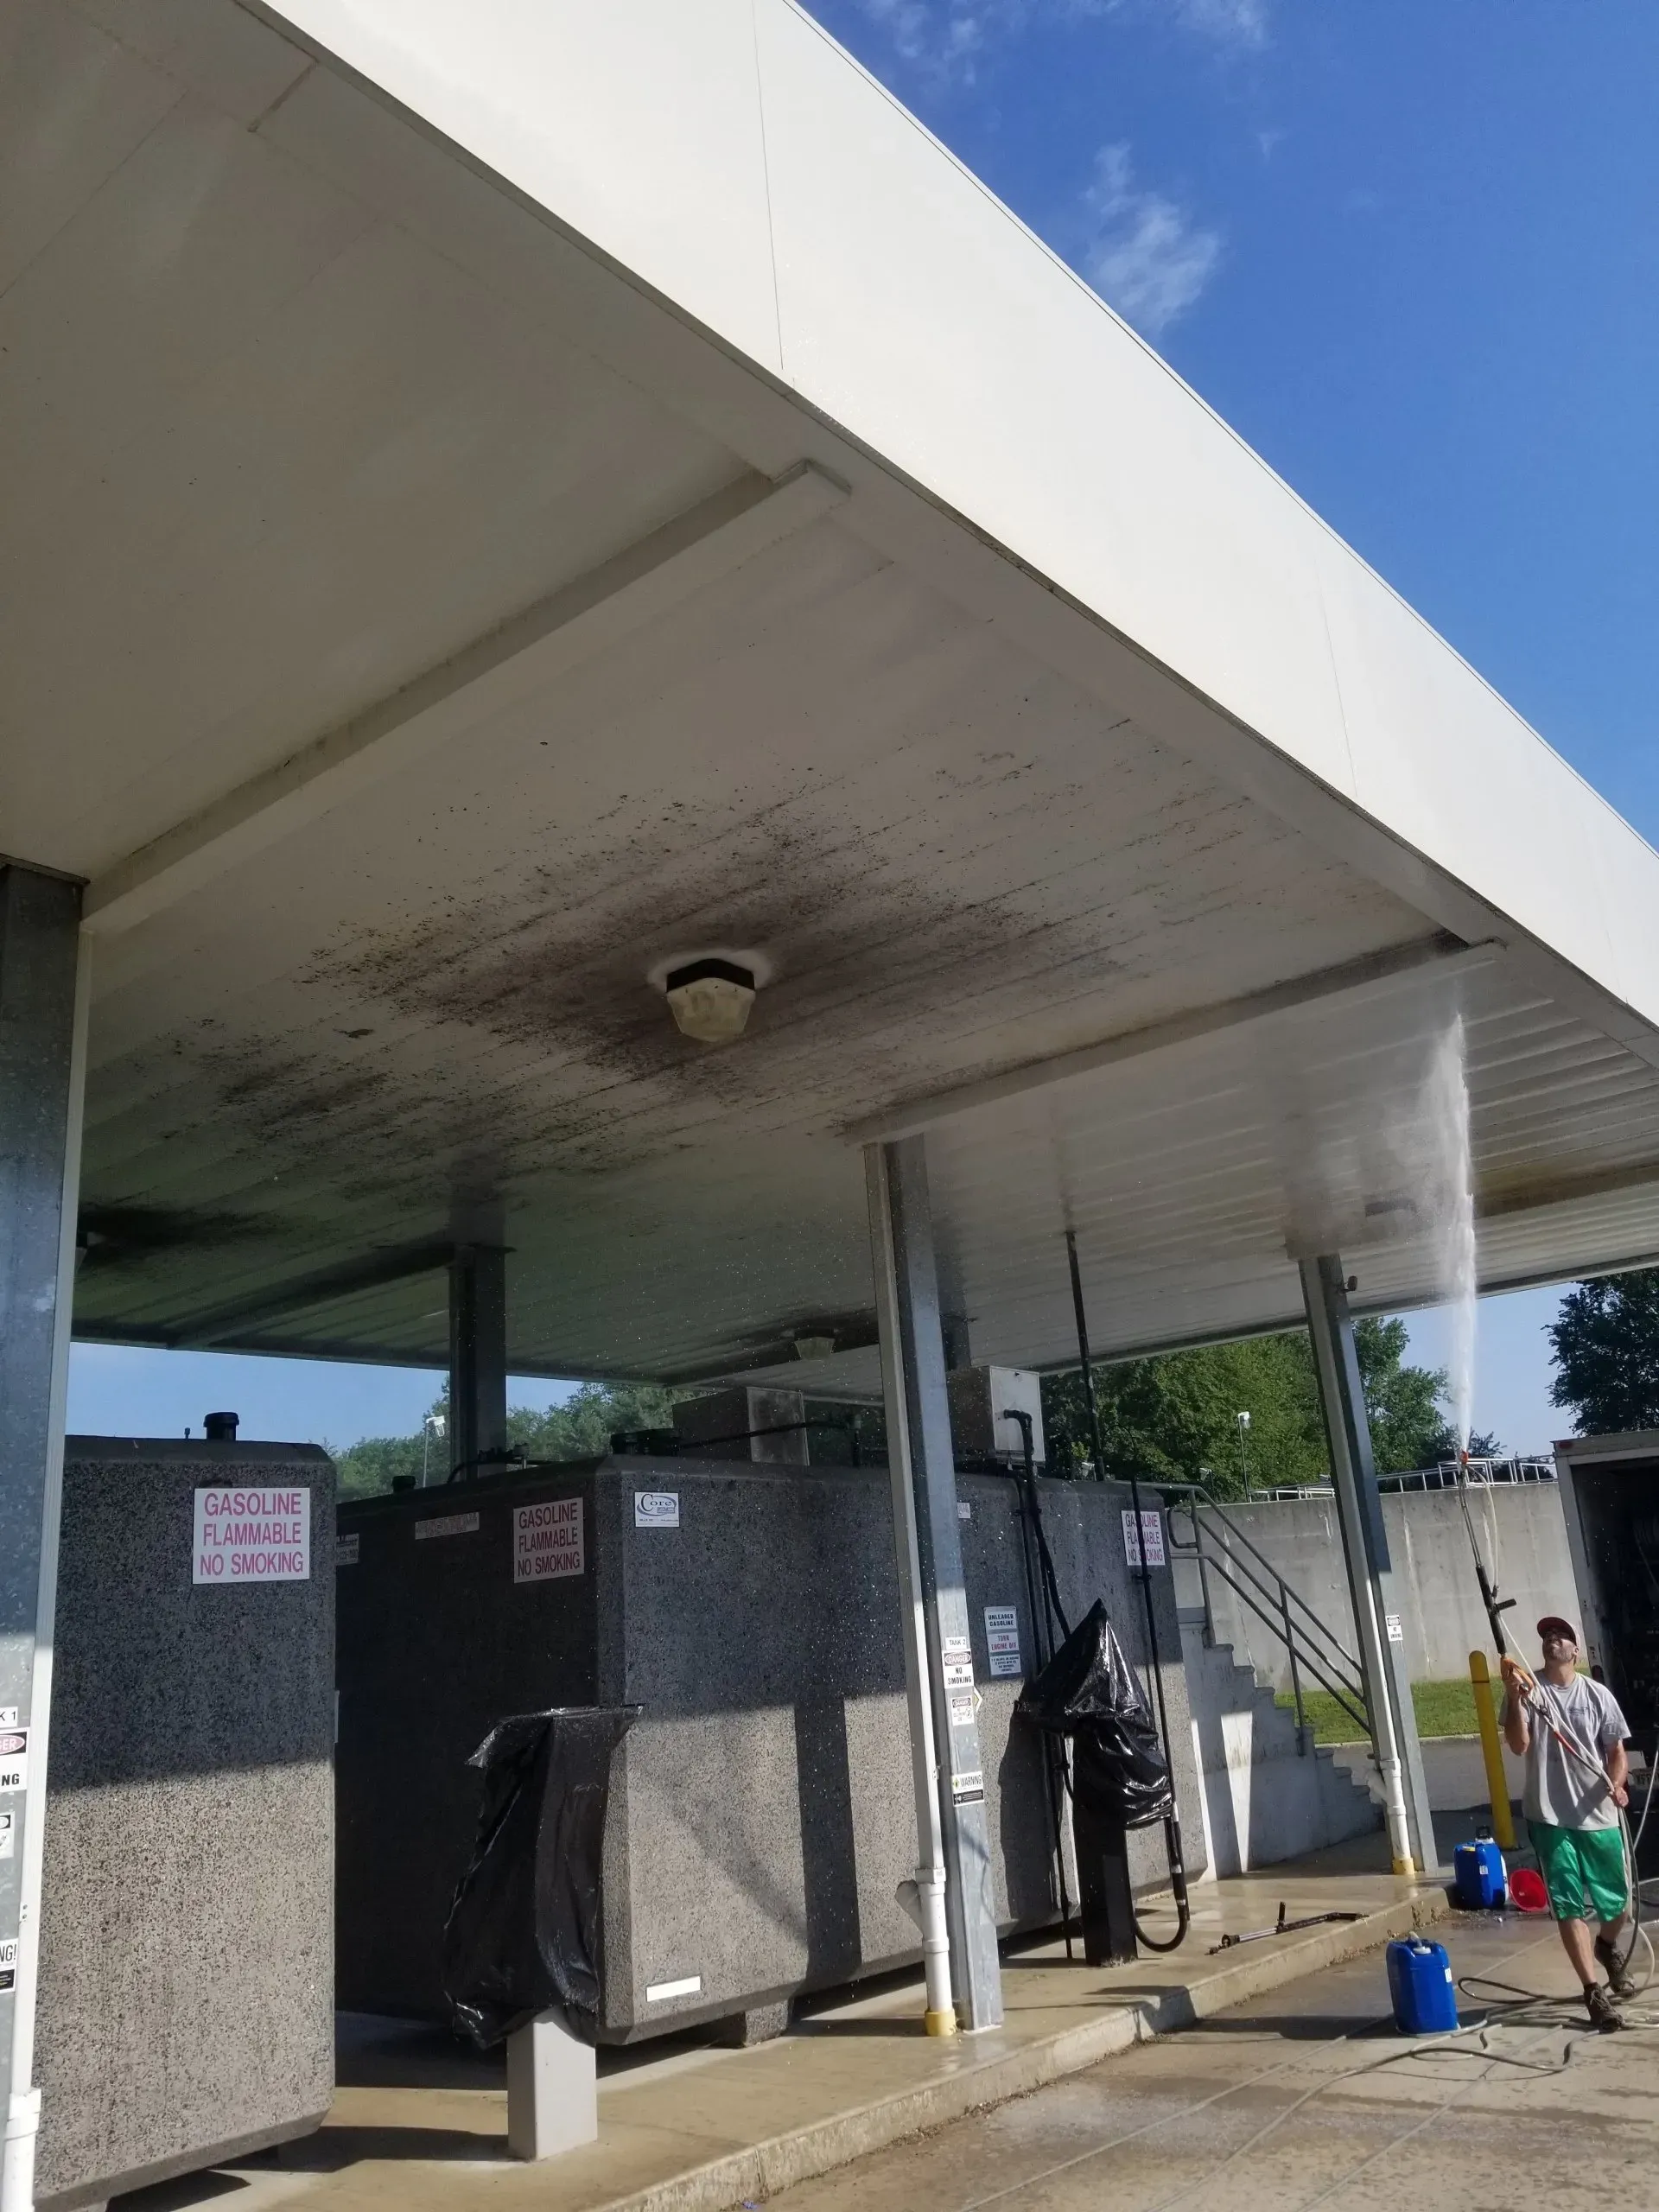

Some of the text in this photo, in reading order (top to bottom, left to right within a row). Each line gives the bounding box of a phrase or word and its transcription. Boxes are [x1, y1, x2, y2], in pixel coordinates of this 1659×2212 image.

[204, 1492, 302, 1516] GASOLINE
[641, 1493, 672, 1512] Core
[518, 1502, 578, 1529] GASOLINE
[203, 1522, 302, 1547] FLAMMABLE
[518, 1526, 578, 1554] FLAMMABLE
[200, 1551, 303, 1576] NO SMOKING
[518, 1551, 580, 1577] NO SMOKING
[1128, 1548, 1137, 1561] NO
[947, 1675, 972, 1685] SMOKING
[11, 1711, 16, 1721] 1
